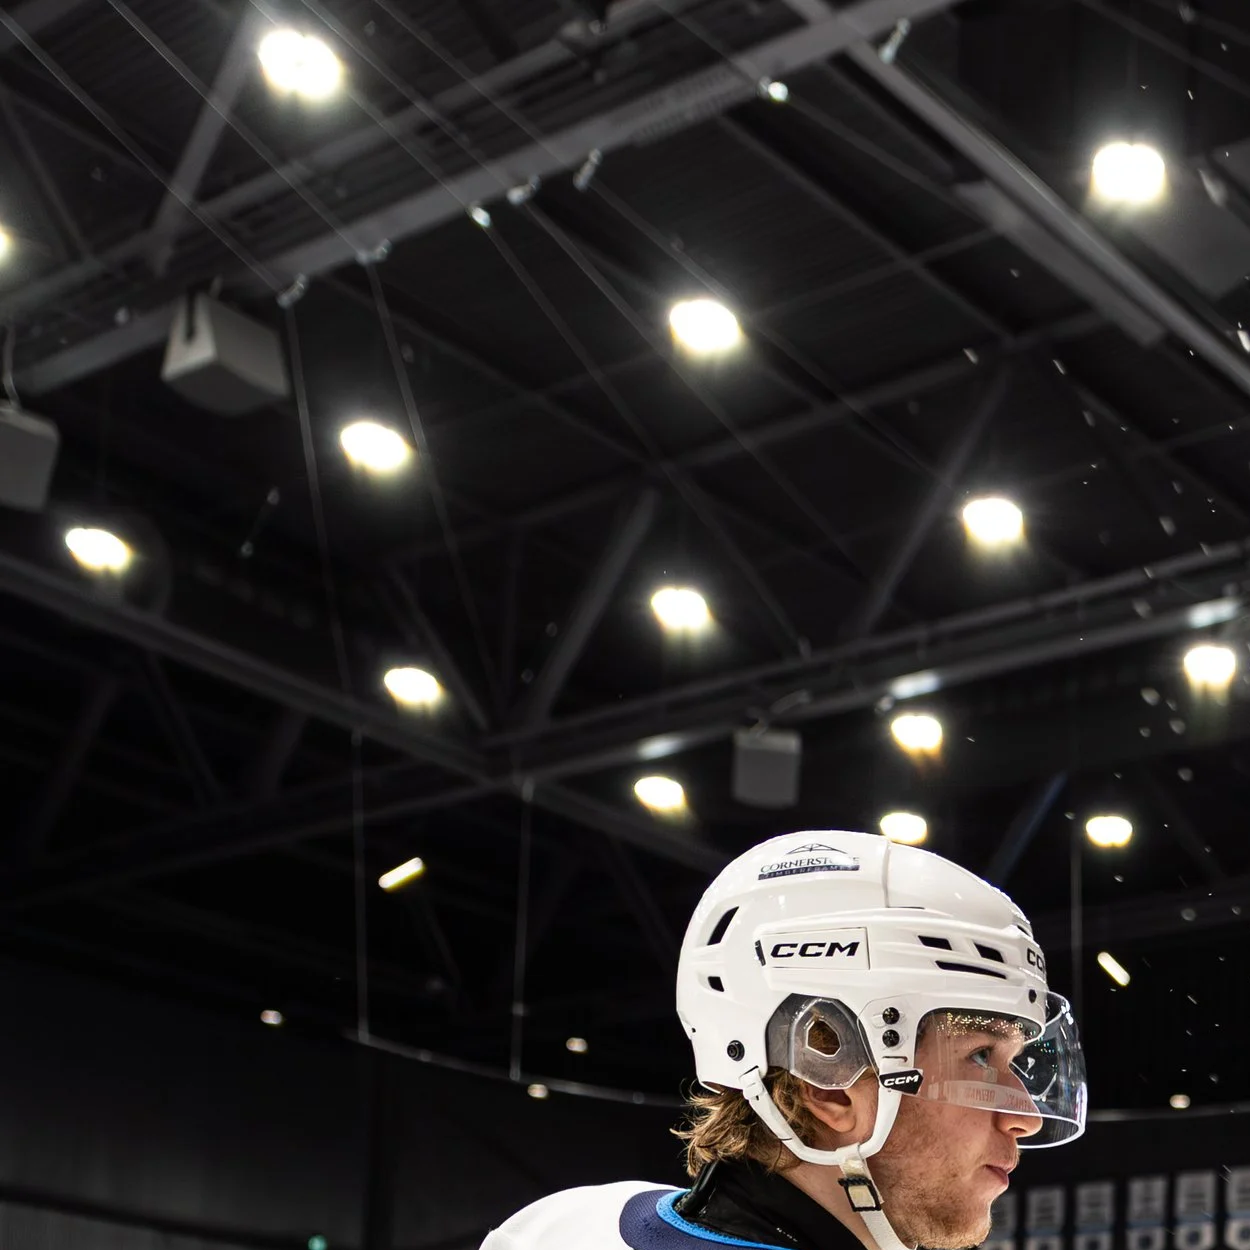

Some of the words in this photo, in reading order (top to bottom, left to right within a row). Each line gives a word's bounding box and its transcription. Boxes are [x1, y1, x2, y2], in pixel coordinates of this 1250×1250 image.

[770, 941, 860, 958] CCM
[1026, 947, 1046, 973] CC
[883, 1075, 920, 1086] CCM
